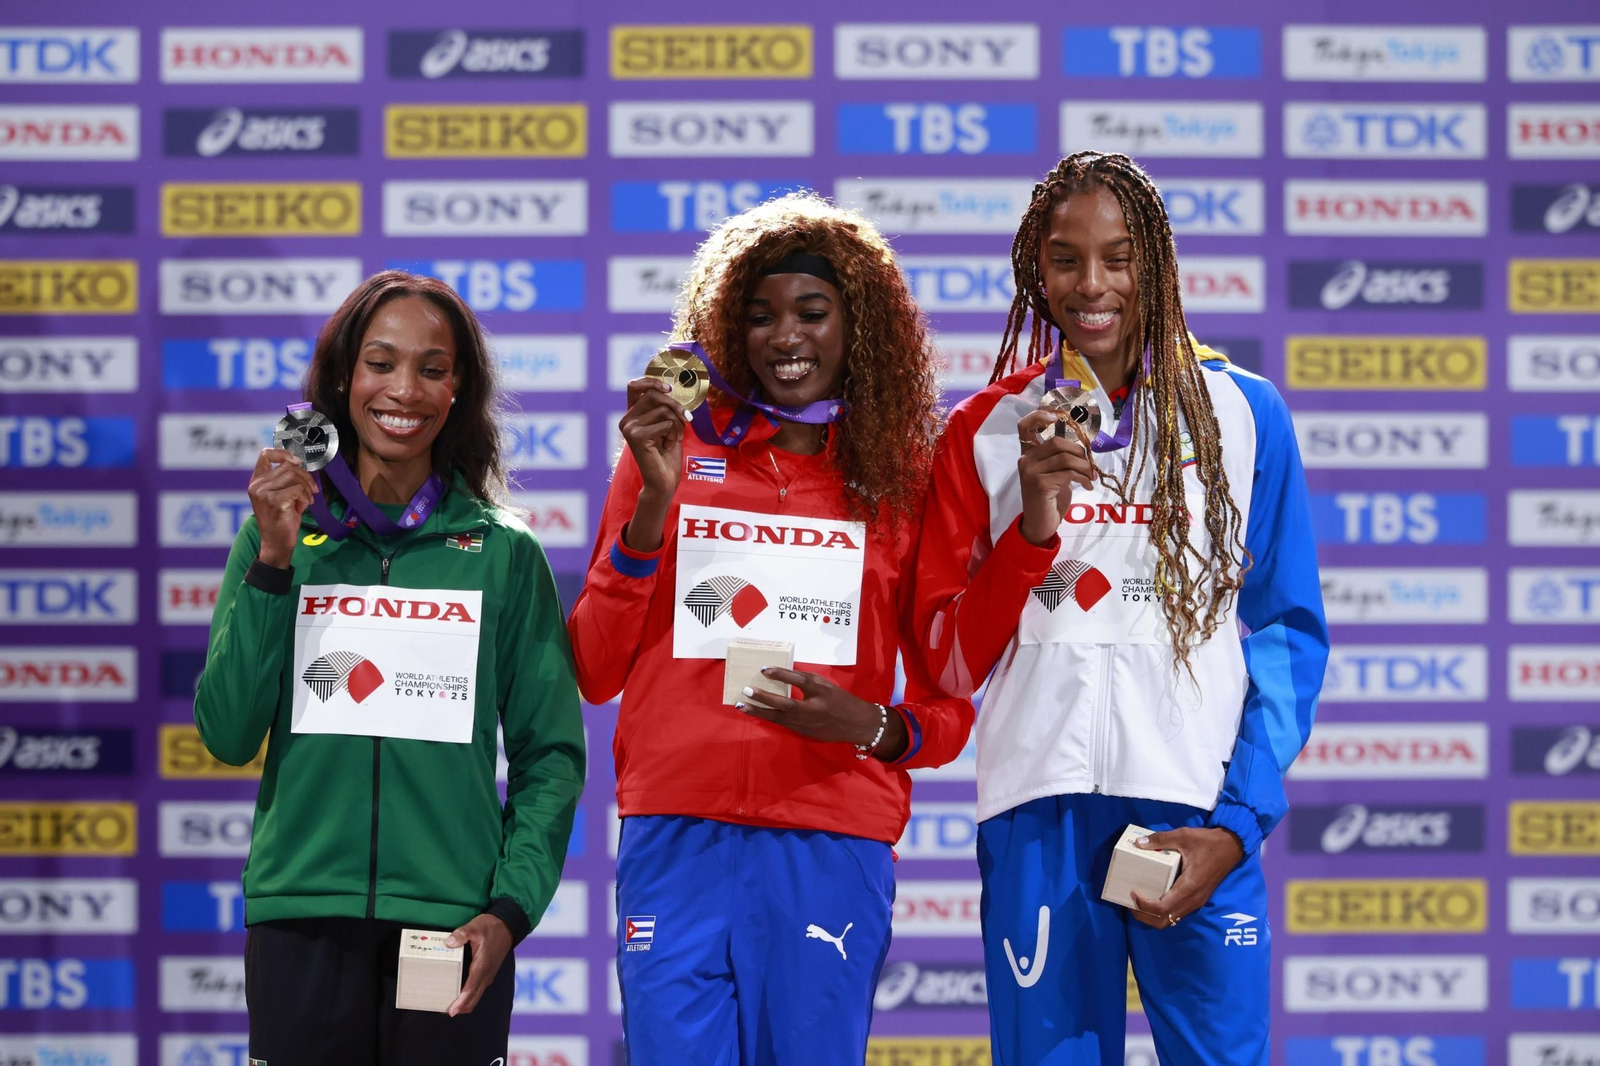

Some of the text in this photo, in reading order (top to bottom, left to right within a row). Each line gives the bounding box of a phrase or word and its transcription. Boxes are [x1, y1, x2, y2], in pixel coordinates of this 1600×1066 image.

[0, 37, 118, 73] TDK
[170, 42, 352, 68] HONDA
[617, 34, 804, 74] SEIKO
[856, 36, 1018, 69] SONY
[1111, 28, 1214, 78] TBS
[0, 121, 127, 146] ONDA
[391, 113, 578, 153] SEIKO
[629, 113, 790, 147] SONY
[885, 103, 990, 154] TBS
[1343, 113, 1467, 150] TDK
[170, 191, 354, 230] SEIKO
[403, 191, 566, 225] SONY
[1163, 188, 1241, 224] DK
[1297, 196, 1476, 222] HONDA
[0, 268, 128, 307] EIKO
[181, 269, 338, 303] SONY
[433, 261, 537, 312] TBS
[0, 347, 114, 381] ONY
[207, 338, 310, 391] TBS
[1295, 344, 1477, 384] SEIKO
[1529, 346, 1600, 380] SO
[1306, 423, 1465, 458] SONY
[687, 474, 724, 484] ATLETISMO
[682, 518, 860, 550] HONDA
[1334, 493, 1439, 544] TBS
[0, 577, 117, 616] TDK
[1122, 578, 1150, 586] WORLD
[301, 596, 476, 623] HONDA
[778, 603, 851, 617] CHAMPIONSHIPS
[779, 596, 852, 610] WORLD ATHLETICS
[0, 660, 128, 689] ONDA
[394, 679, 468, 692] CHAMPIONSHIPS
[395, 672, 469, 684] WORLD ATHLETICS
[1344, 655, 1467, 691] TDK
[1297, 739, 1477, 765] HONDA
[0, 809, 129, 849] EIKO
[180, 812, 252, 846] SO
[904, 814, 977, 848] TD
[0, 887, 114, 923] ONY
[1295, 883, 1478, 927] SEIKO
[1529, 886, 1600, 923] SO
[626, 944, 651, 952] ATLETISMO
[1224, 927, 1258, 947] RS
[1305, 964, 1466, 1001] SONY
